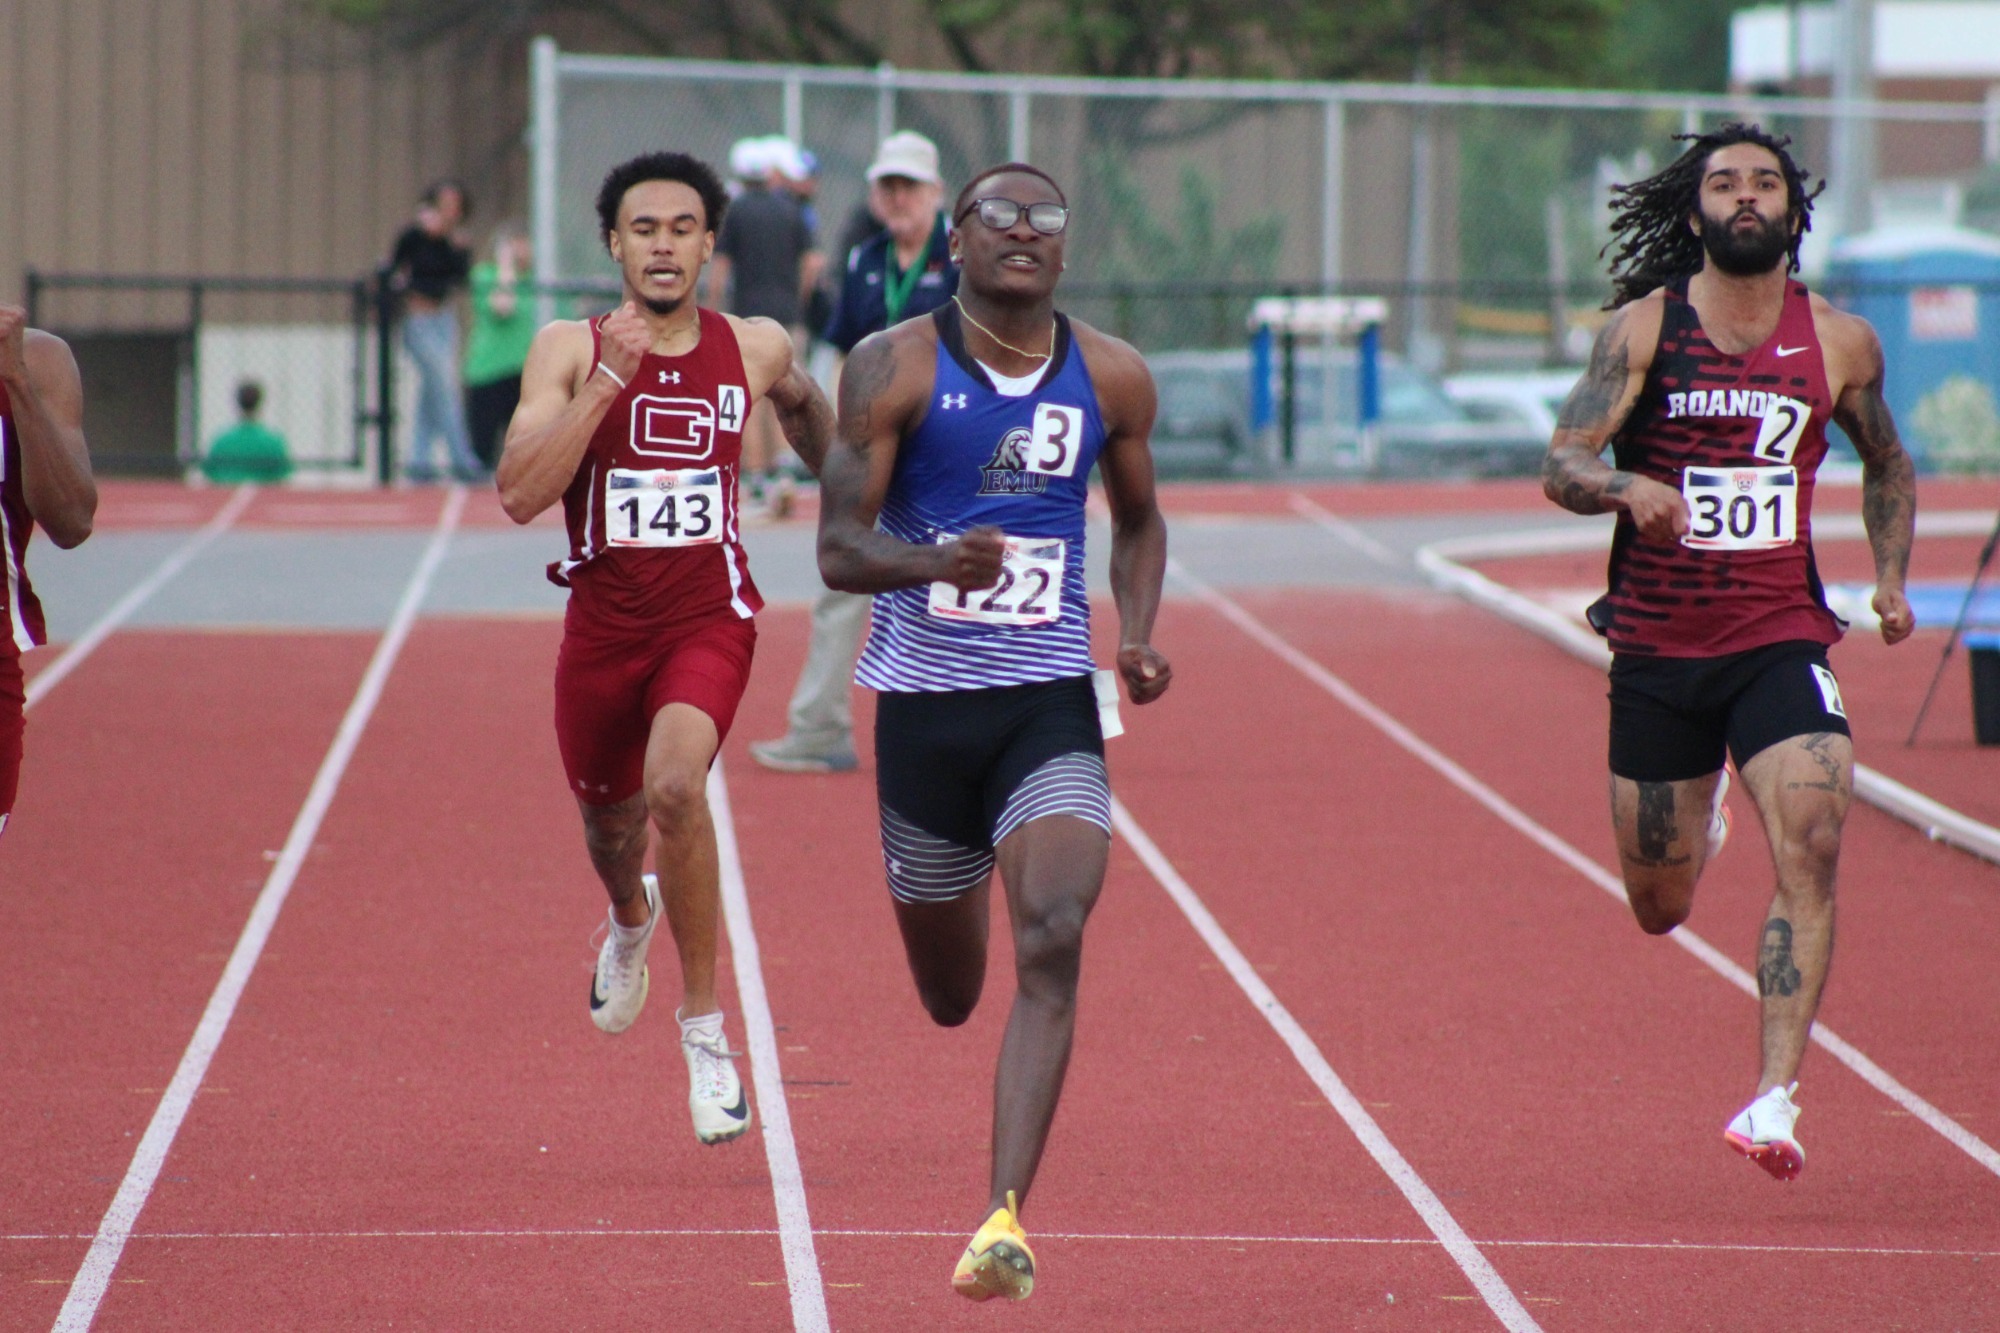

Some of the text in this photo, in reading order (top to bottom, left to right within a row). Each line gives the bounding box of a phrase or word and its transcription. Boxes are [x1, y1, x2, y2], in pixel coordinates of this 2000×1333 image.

[720, 389, 737, 428] 4
[1667, 389, 1806, 418] ROANO
[1038, 409, 1070, 471] 3
[1764, 405, 1798, 459] 2
[984, 469, 1045, 493] EMU
[618, 494, 712, 538] 143
[1692, 494, 1782, 539] 301
